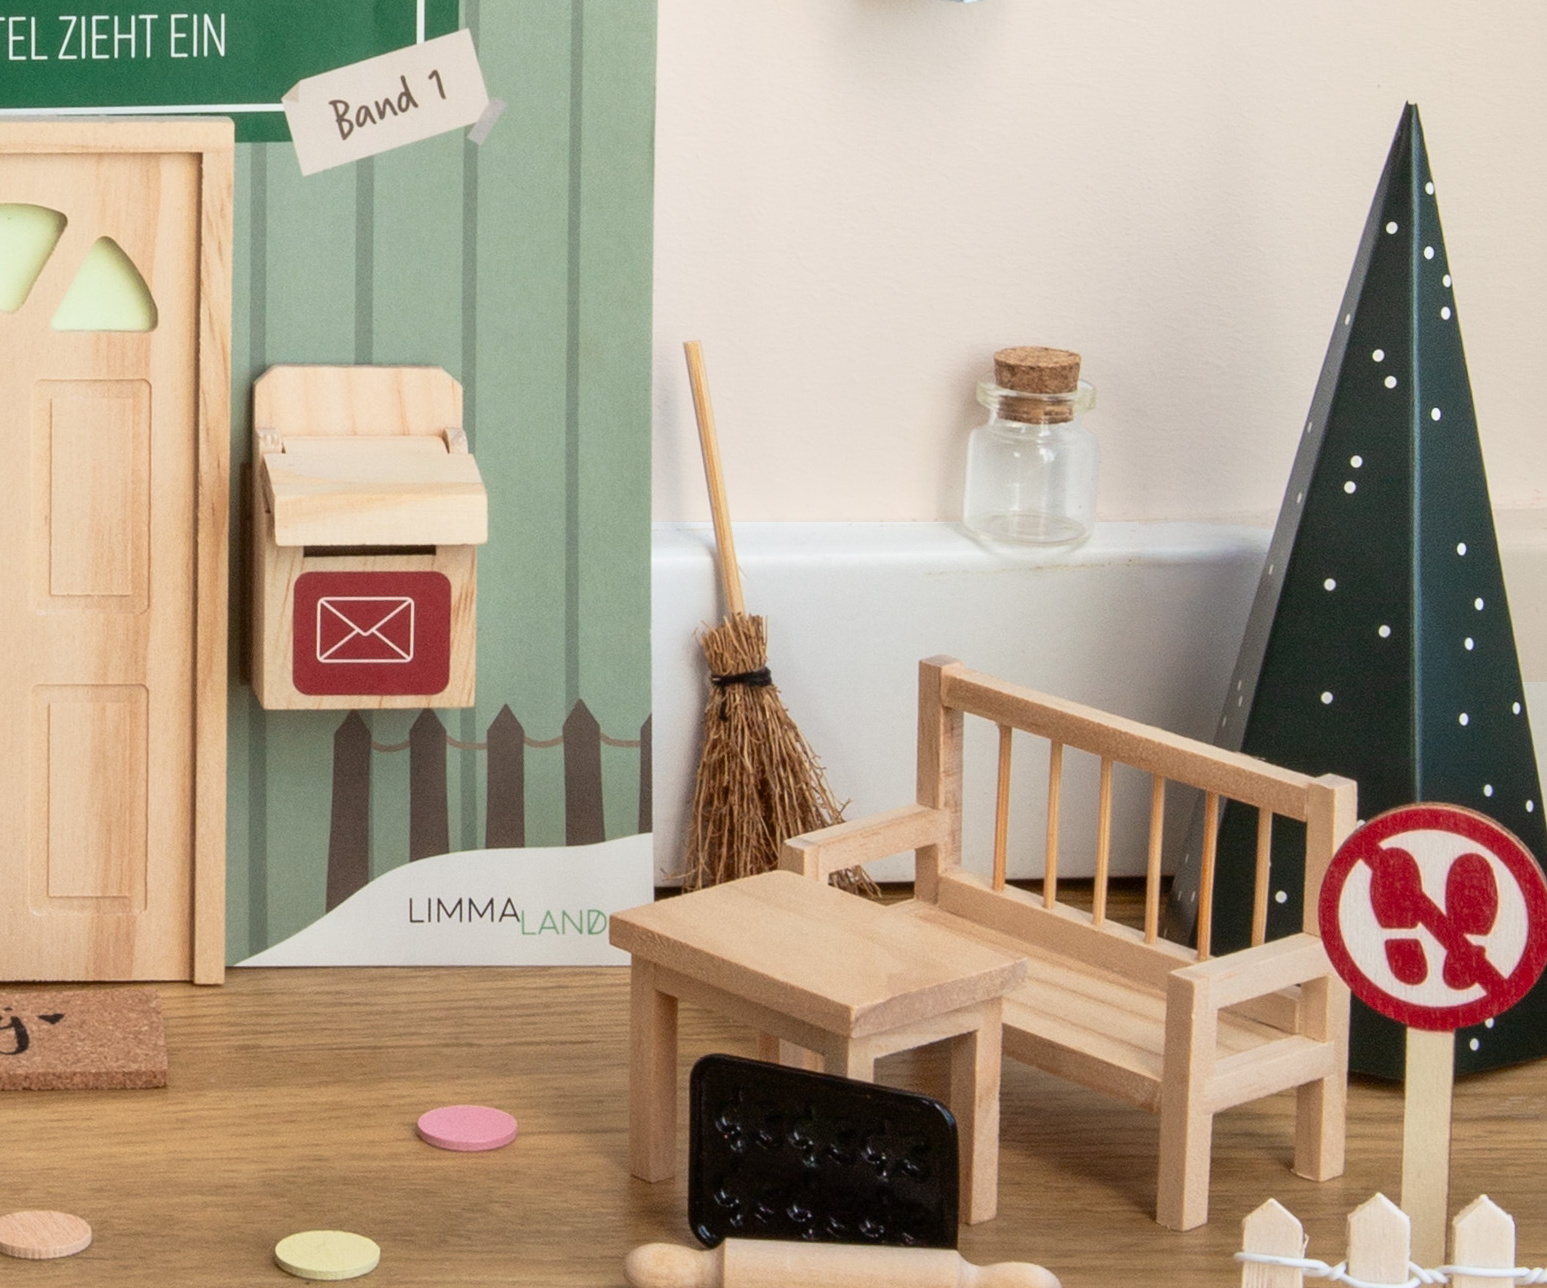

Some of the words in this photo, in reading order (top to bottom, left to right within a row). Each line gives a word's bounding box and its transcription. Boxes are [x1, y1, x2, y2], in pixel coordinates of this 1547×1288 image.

[58, 14, 158, 60] ZIEHT
[170, 13, 226, 58] EIN
[328, 74, 419, 141] Band
[427, 69, 446, 100] 1
